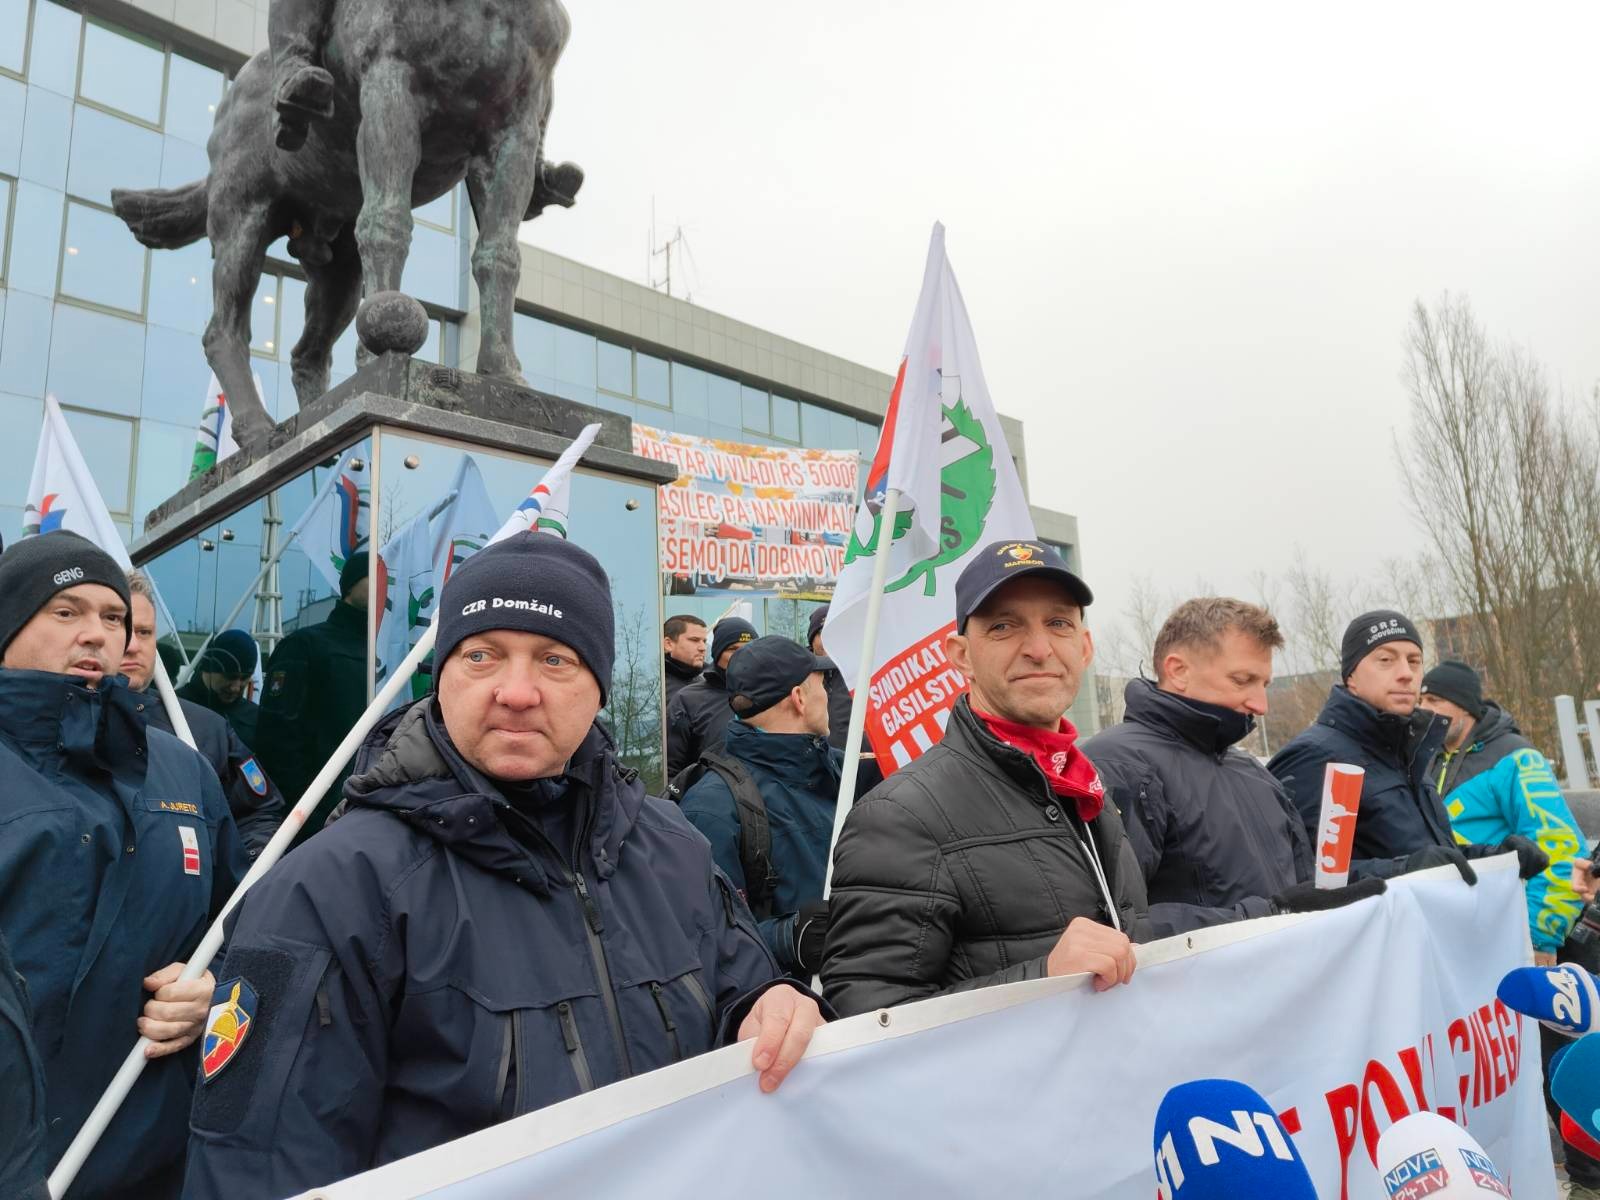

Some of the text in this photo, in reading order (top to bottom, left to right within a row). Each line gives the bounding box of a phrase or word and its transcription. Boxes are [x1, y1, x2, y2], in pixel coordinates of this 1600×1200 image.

[633, 439, 709, 476] KRETAR
[711, 452, 723, 478] V
[727, 455, 776, 485] VLADI
[780, 462, 804, 486] RS
[723, 497, 748, 523] PA
[751, 501, 778, 527] NA
[661, 528, 723, 578] ŠEMO,
[729, 542, 752, 574] DA
[757, 545, 824, 576] DOBIMO
[462, 597, 563, 618] CZR Domžale
[869, 639, 948, 710] SINDIKAT
[881, 668, 971, 737] GASILSTV
[1188, 1110, 1295, 1166] N1
[1385, 1150, 1442, 1193] NOVA
